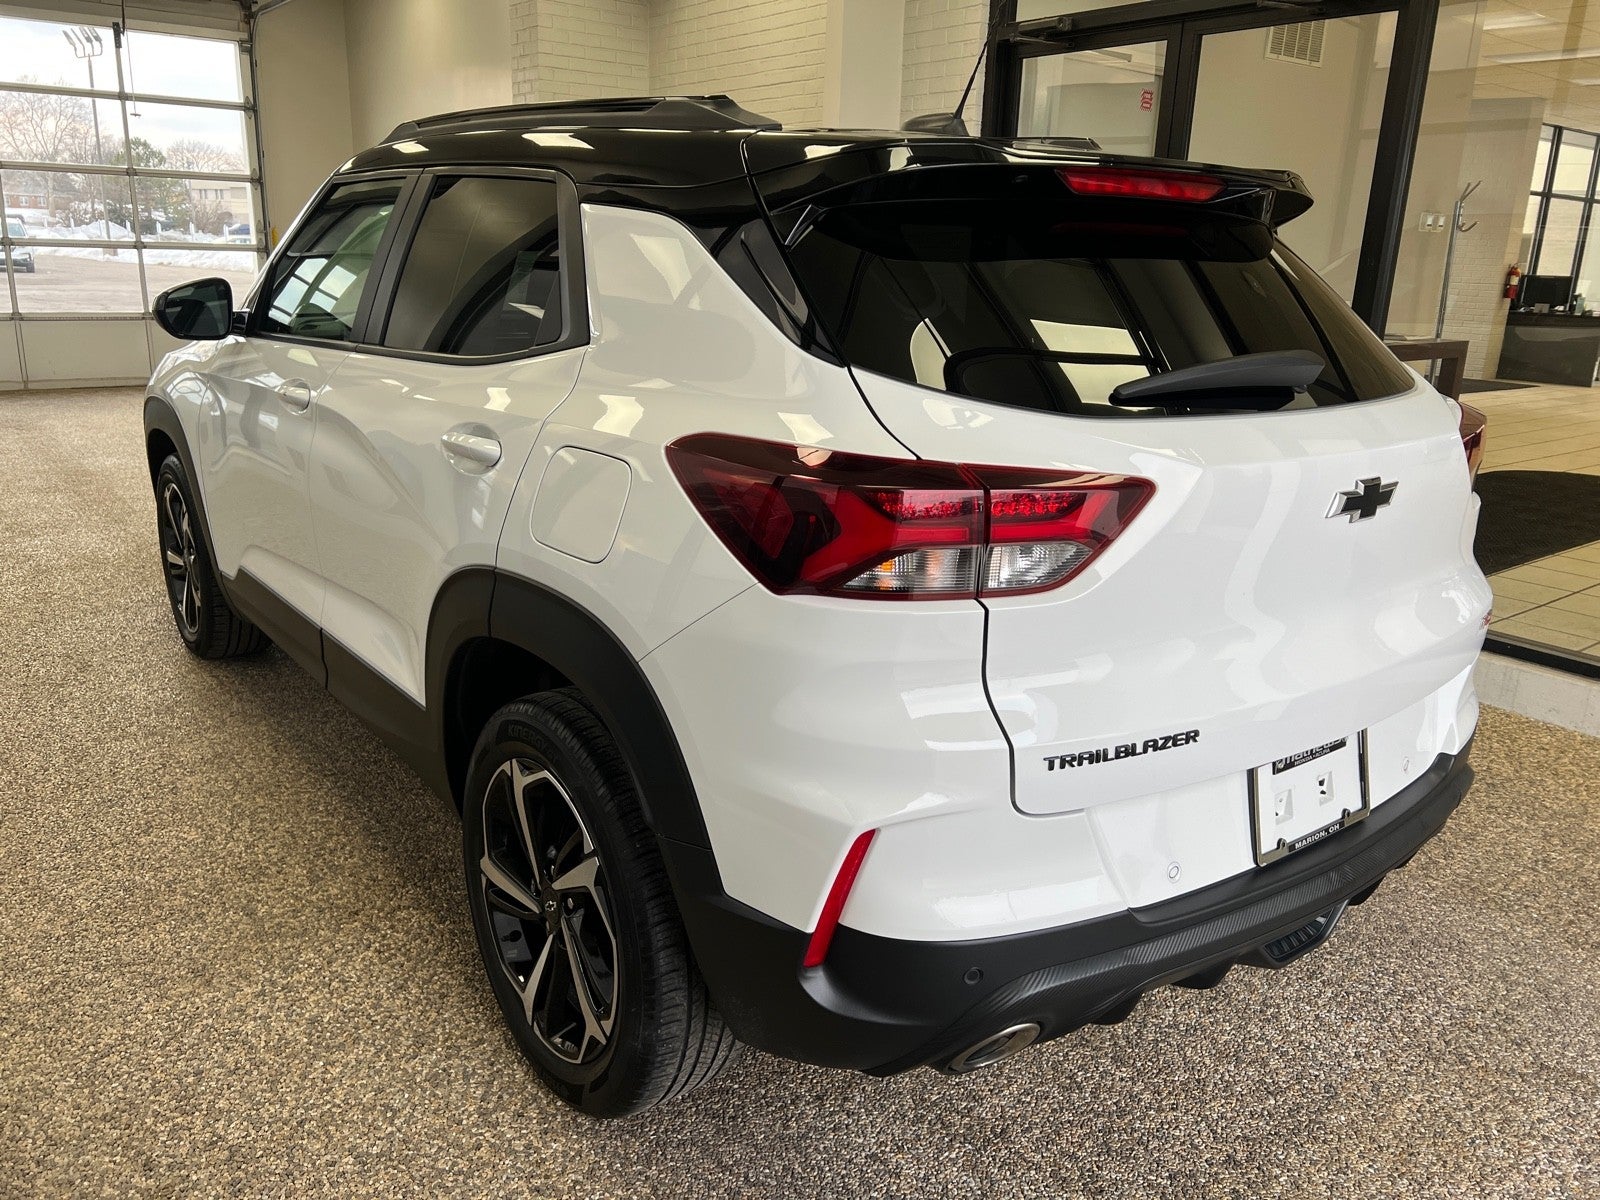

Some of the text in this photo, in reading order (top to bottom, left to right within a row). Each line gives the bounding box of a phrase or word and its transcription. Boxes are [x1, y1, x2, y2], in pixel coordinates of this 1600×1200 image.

[1043, 729, 1200, 771] TRAILBLAZER
[1294, 823, 1340, 850] MARION, OH
